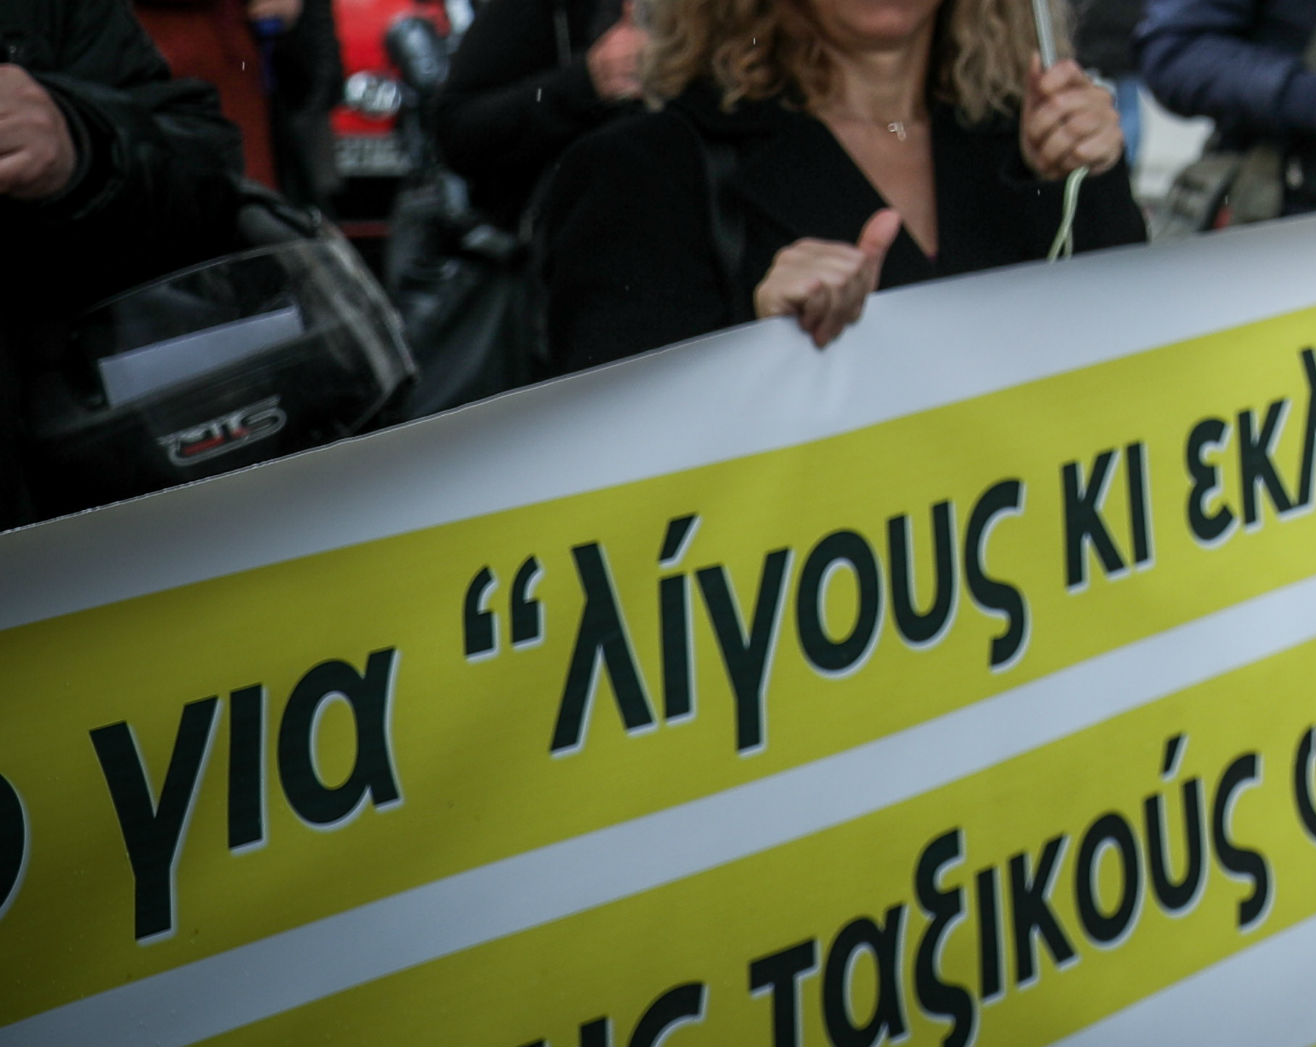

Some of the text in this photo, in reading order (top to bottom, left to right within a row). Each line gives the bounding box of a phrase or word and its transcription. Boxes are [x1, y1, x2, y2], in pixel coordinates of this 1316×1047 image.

[88, 646, 401, 944] για
[1061, 442, 1151, 589] κι
[747, 732, 1271, 1047] ταξικούς
